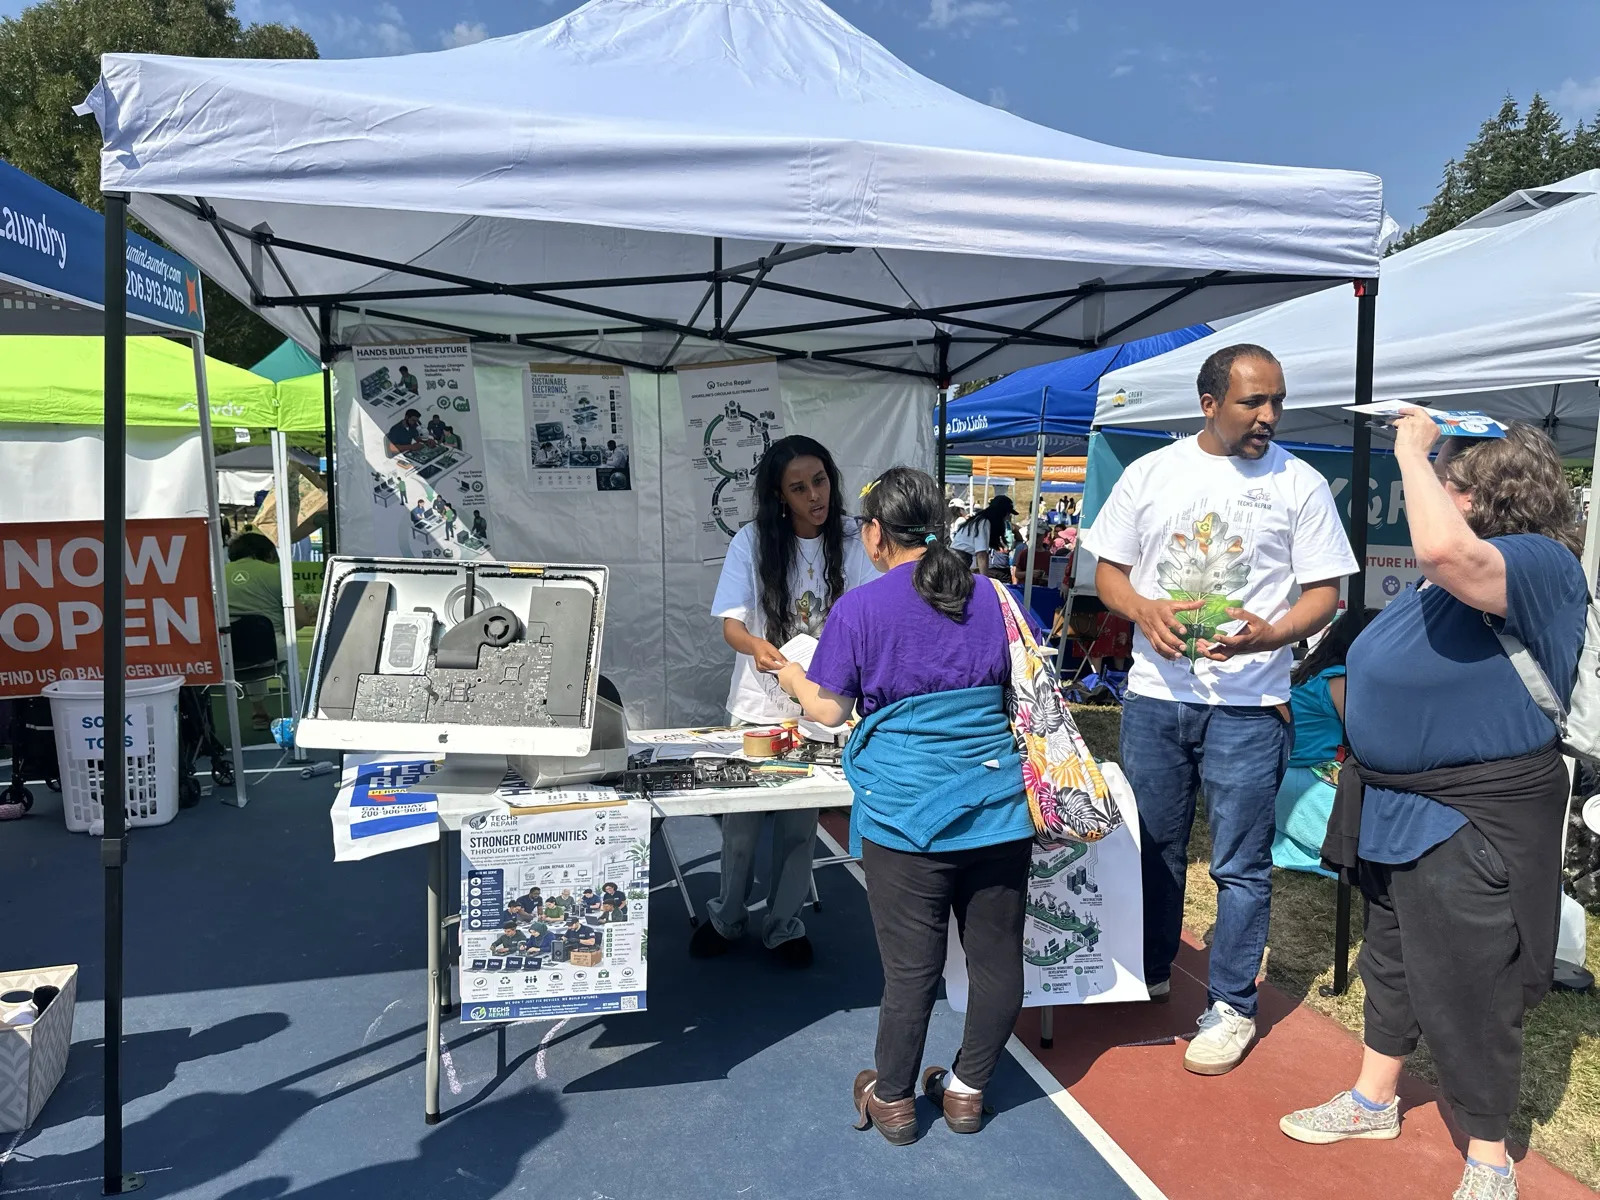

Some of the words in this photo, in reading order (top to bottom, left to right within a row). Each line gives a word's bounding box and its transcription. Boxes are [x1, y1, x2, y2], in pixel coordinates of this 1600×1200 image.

[126, 244, 182, 284] uminLaundry.com
[126, 268, 185, 315] 206.913.2003
[356, 348, 388, 356] HANDS
[389, 347, 415, 356] BUILD
[434, 346, 468, 354] FUTURE
[531, 378, 567, 386] SUSTAINABLE
[532, 385, 568, 394] ELECTRONICS
[1237, 500, 1253, 508] TECHS
[1254, 502, 1272, 510] REPAIR
[3, 535, 187, 590] NOW
[0, 596, 202, 653] OPEN
[0, 669, 34, 686] FIND
[36, 668, 57, 683] US
[60, 668, 74, 680] @
[76, 663, 154, 680] BALGER
[154, 661, 214, 676] VILLAGE
[82, 714, 133, 729] SOK
[84, 735, 134, 750] TOS
[377, 763, 439, 776] TEC
[491, 814, 518, 822] TECHS
[470, 835, 520, 848] STRONGER
[524, 830, 588, 844] COMMUNITIES
[512, 843, 562, 852] TECHNOLOGY
